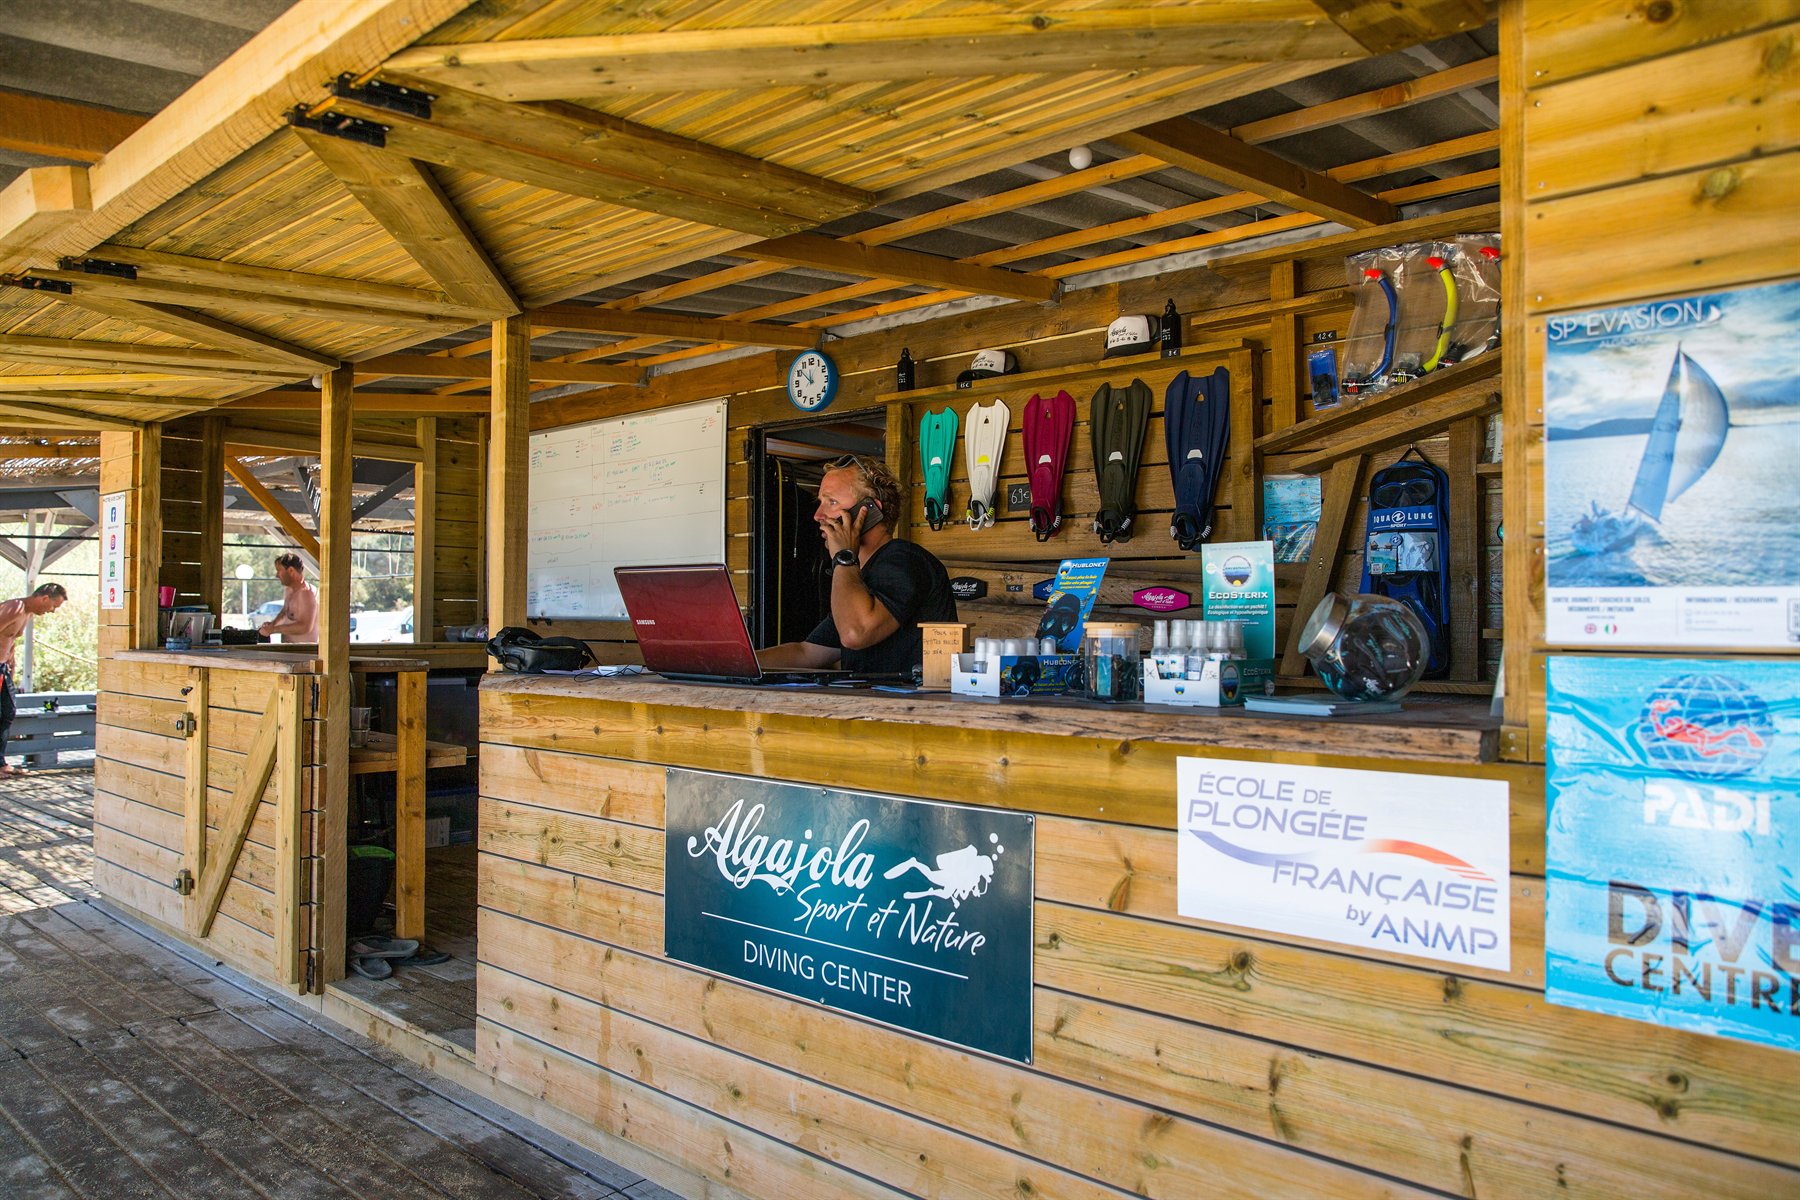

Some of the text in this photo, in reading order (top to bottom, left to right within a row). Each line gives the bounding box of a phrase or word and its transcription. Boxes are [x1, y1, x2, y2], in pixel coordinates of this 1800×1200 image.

[1549, 300, 1702, 341] SP EVASION
[802, 361, 806, 369] 11
[808, 357, 815, 365] 12
[817, 359, 820, 367] 1
[821, 365, 826, 373] 2
[824, 375, 829, 383] 3
[795, 380, 800, 388] 9
[802, 396, 807, 404] 7
[810, 397, 814, 405] 6
[1407, 512, 1433, 520] LUNG
[1072, 561, 1106, 569] HUBLONET
[1209, 592, 1268, 600] ECOSTERIX
[1198, 771, 1332, 806] ÉCOLE DE
[1643, 783, 1771, 836] PADI
[1187, 799, 1368, 841] PLONGÉE
[687, 798, 875, 897] Algajola
[1272, 859, 1499, 915] FRANÇAISE
[793, 883, 986, 956] Sport et Nature
[1346, 904, 1498, 956] by ANMP
[743, 940, 912, 1008] DIVING CENTER
